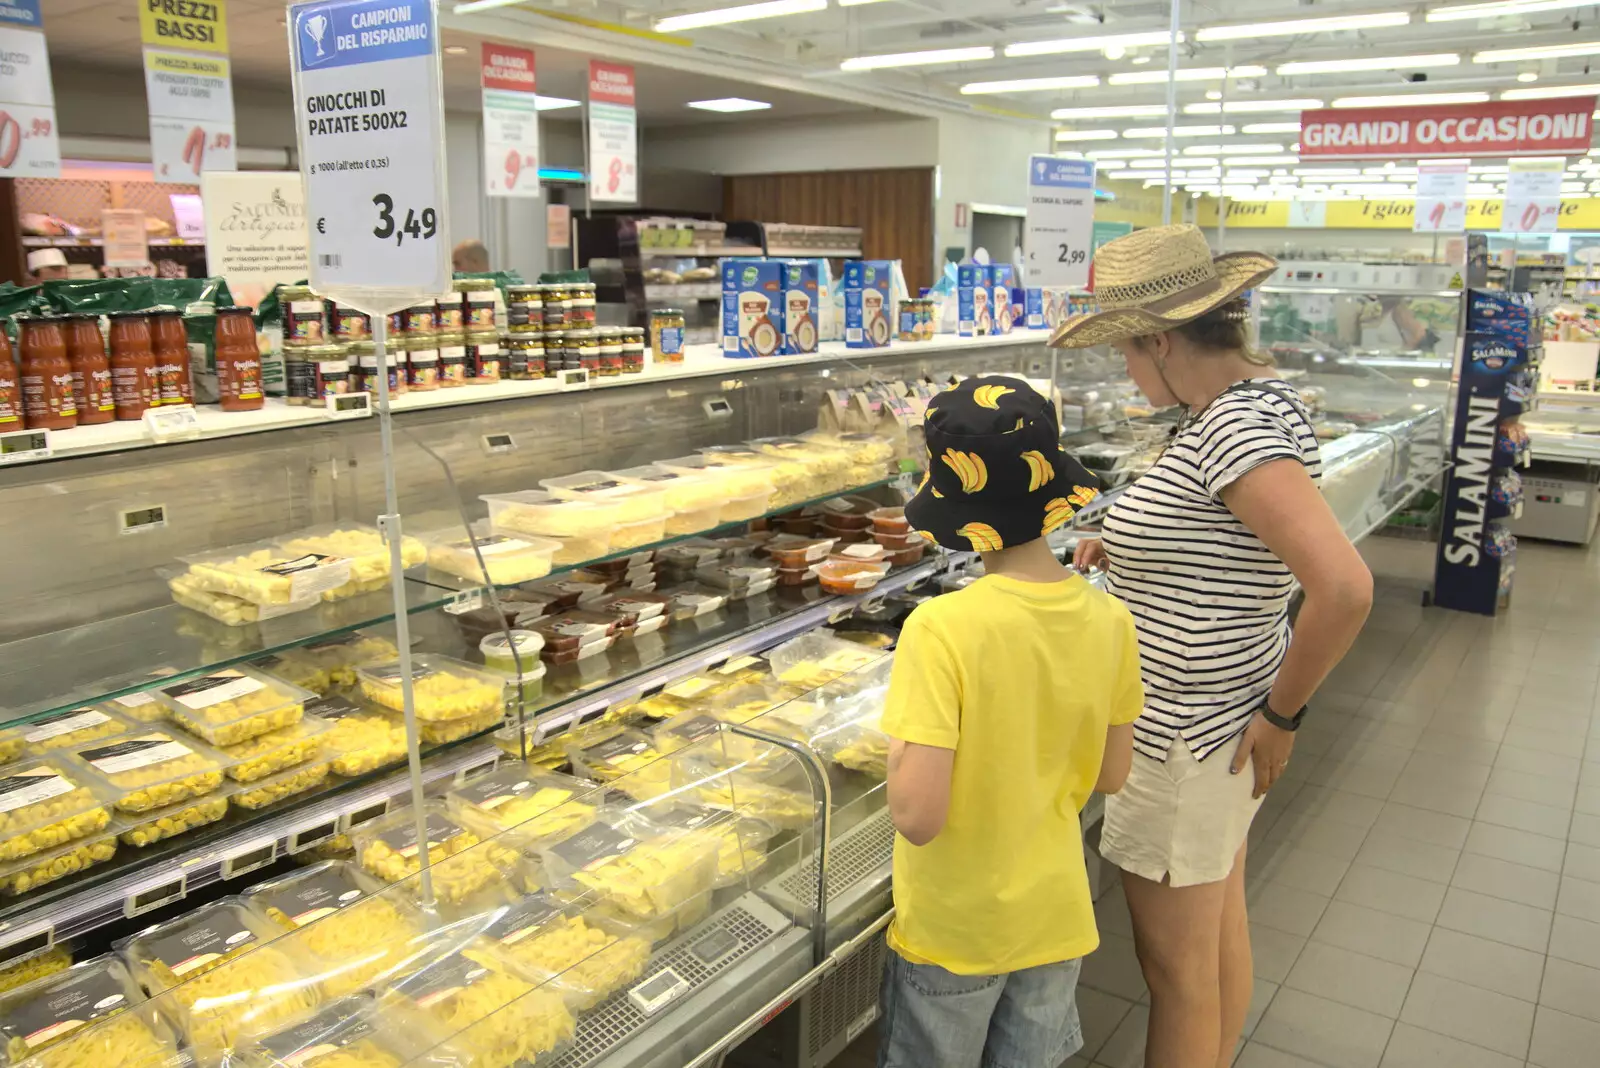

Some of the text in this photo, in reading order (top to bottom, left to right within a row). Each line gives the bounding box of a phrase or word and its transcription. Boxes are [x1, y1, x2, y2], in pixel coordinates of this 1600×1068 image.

[148, 0, 218, 22] PREZZI
[351, 5, 412, 29] CAMPIONI
[155, 18, 215, 43] BASSI
[337, 22, 428, 51] DEL RISPARMIO
[307, 89, 386, 113] GNOCCHI DI
[309, 111, 408, 136] PATATE 500X2
[1304, 112, 1589, 147] GRANDI OCCASIONI
[316, 193, 437, 247] € 3,49
[1373, 200, 1415, 221] gior
[1480, 200, 1499, 216] le
[1058, 243, 1086, 266] 2,99
[1444, 395, 1499, 568] SALAMINI
